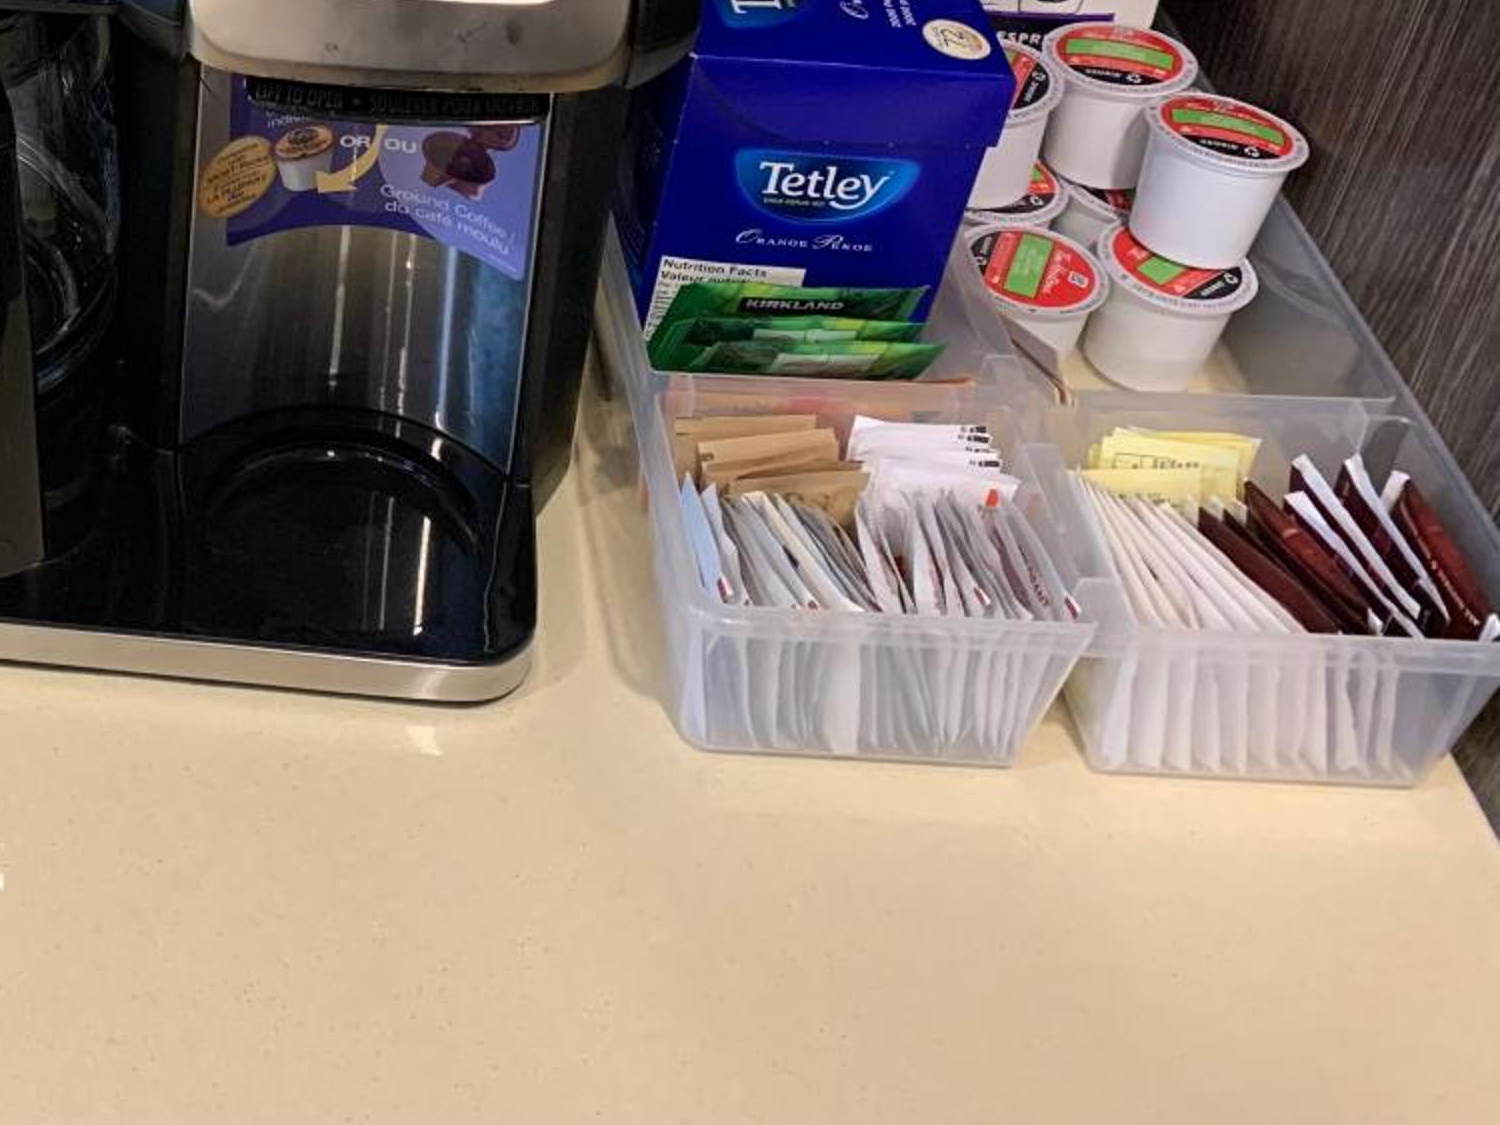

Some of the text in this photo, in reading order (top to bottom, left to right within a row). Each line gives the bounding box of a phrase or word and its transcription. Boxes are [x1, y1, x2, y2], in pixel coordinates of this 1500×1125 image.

[339, 134, 418, 155] OR OU
[758, 161, 891, 211] Tetley
[662, 258, 768, 278] Nutrition Facts
[744, 297, 845, 312] KIRKLAND
